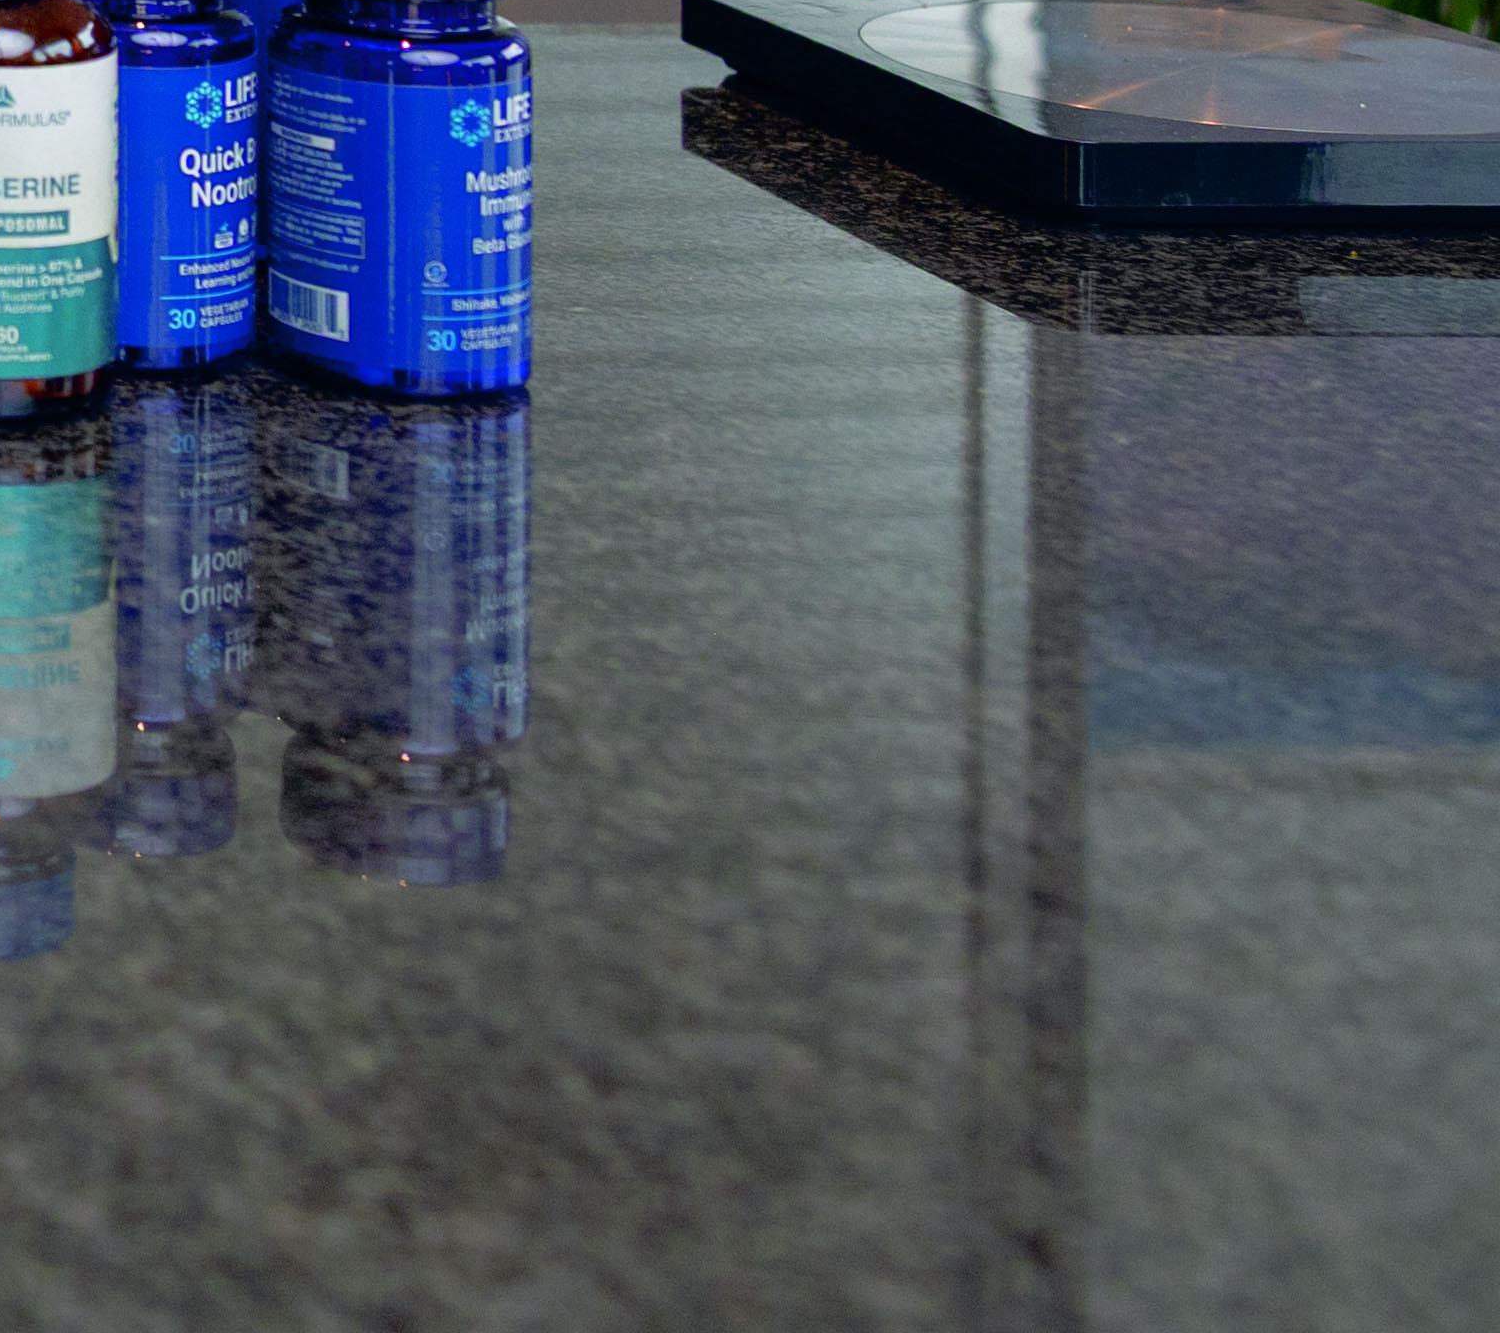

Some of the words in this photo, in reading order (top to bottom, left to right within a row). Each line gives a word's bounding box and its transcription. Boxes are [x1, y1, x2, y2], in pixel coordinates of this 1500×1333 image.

[179, 141, 245, 178] Quick
[472, 237, 506, 255] Beta
[178, 259, 231, 277] Enhanced
[25, 273, 39, 287] in
[40, 271, 65, 287] One
[168, 308, 196, 329] 30
[426, 329, 457, 351] 30
